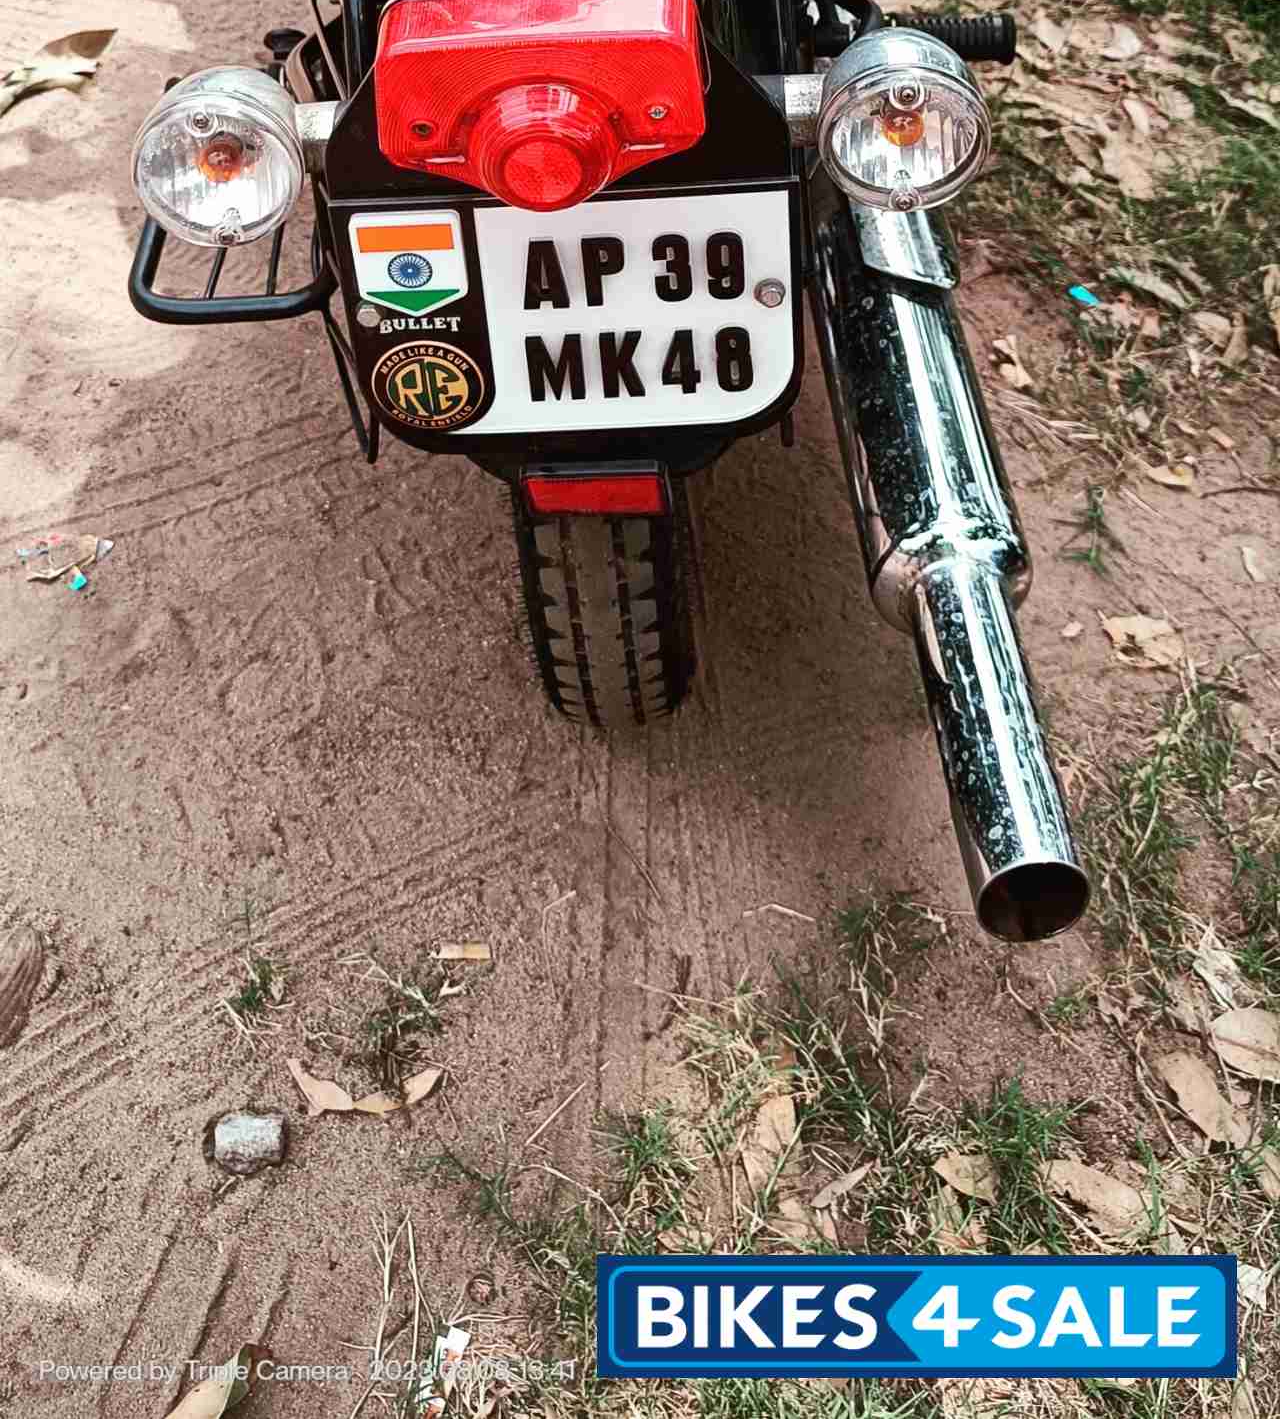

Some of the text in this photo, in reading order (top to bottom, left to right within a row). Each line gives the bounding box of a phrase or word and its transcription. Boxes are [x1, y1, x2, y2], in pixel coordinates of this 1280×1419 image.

[523, 231, 746, 310] AP 39
[379, 316, 461, 334] BULLET
[379, 346, 470, 375] MADE LIKE A GUN
[394, 357, 469, 419] RE
